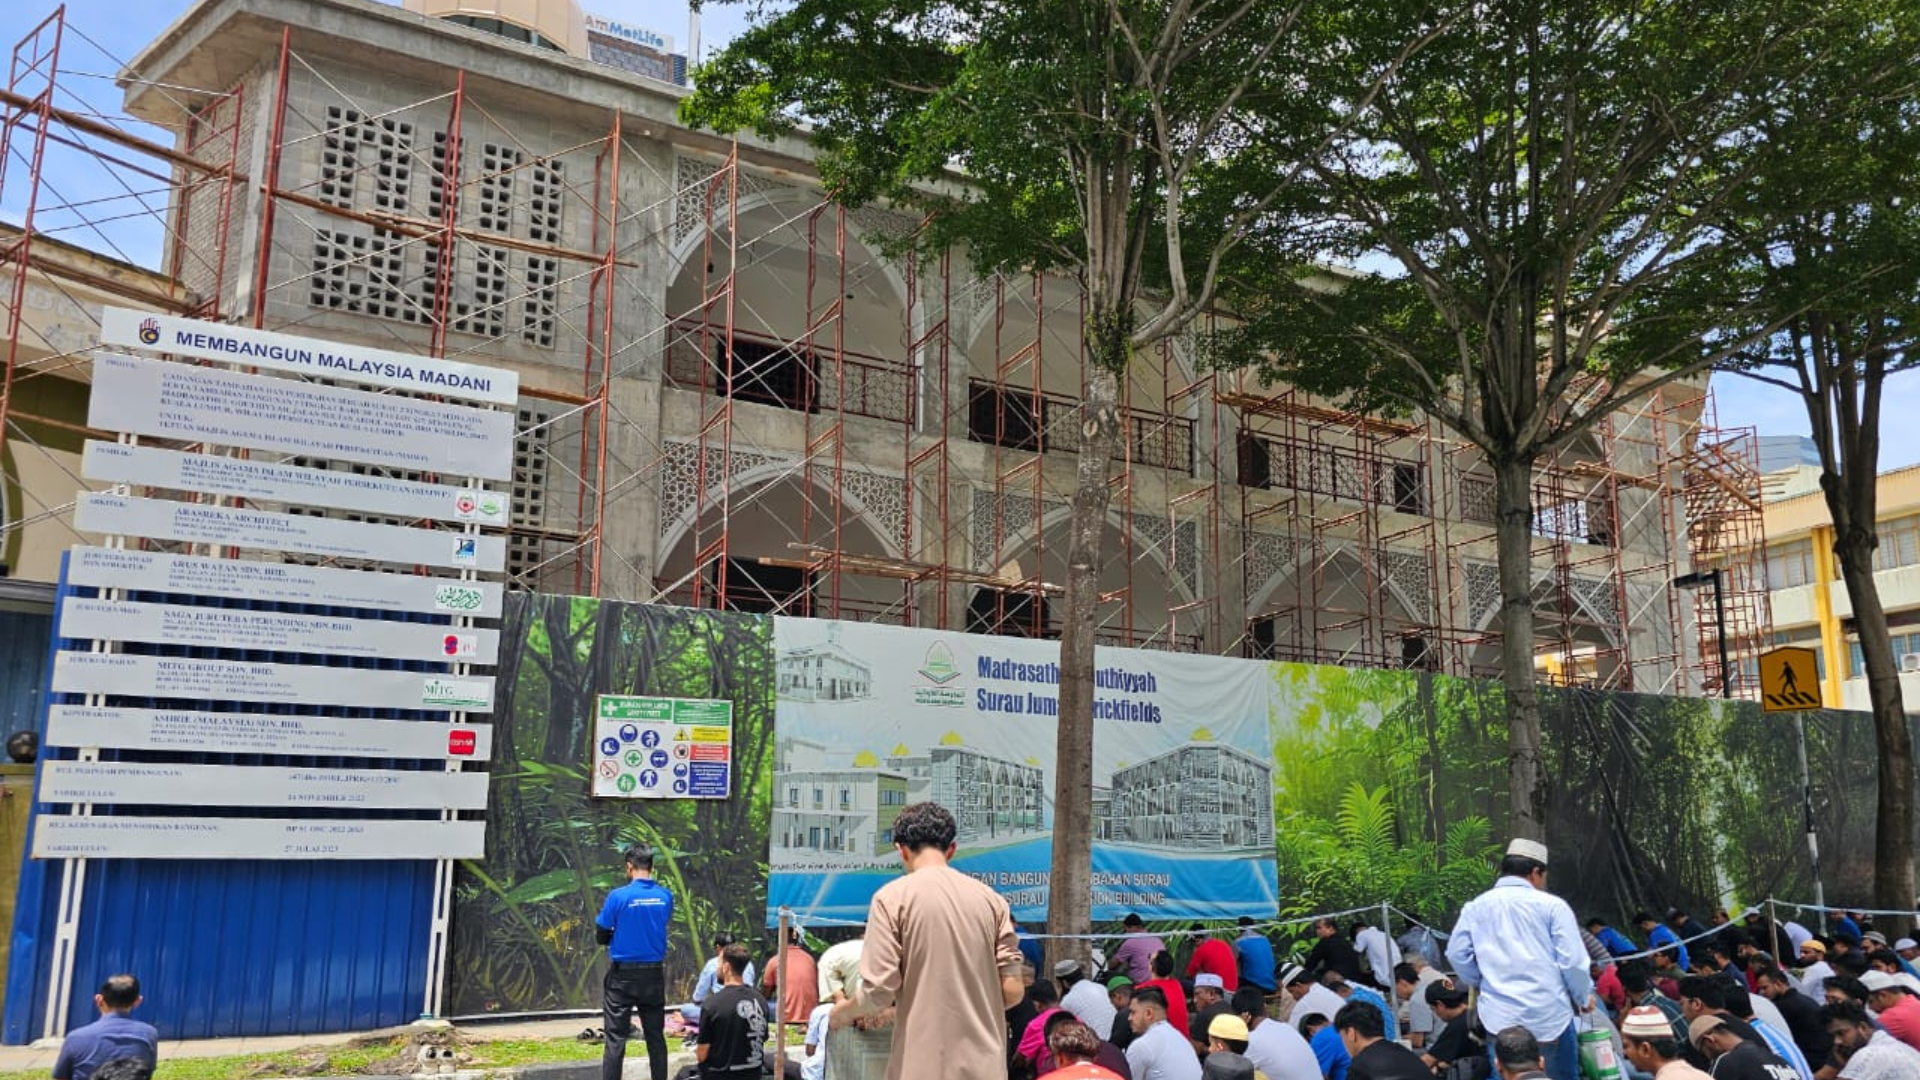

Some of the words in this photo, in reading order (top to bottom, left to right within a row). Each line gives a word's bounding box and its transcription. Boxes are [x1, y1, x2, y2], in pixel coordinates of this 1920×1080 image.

[176, 330, 312, 366] MEMBANGUN
[318, 353, 414, 380] MALAYSIA
[419, 370, 491, 393] MADANI
[182, 458, 221, 471] MAJLIS
[223, 462, 259, 475] AGAMA
[261, 467, 291, 479] ISLAM
[293, 471, 340, 485] WILAYAH
[343, 477, 410, 493] PERSEKUTUAN
[411, 485, 451, 498] (MAIWP)
[234, 513, 290, 527] ARCHITECT
[170, 559, 197, 569] ARUS
[240, 565, 262, 575] SDN.
[263, 567, 286, 577] BHD.
[163, 610, 191, 620] SAGA
[194, 612, 246, 624] JURUTERA
[249, 616, 307, 628] PERUNDING
[156, 661, 185, 671] MITG
[188, 663, 224, 673] GROUP
[250, 667, 274, 676] BHD.
[977, 656, 1059, 684] Madrasath
[1096, 667, 1156, 693] uthiyyah
[976, 688, 1022, 713] Surau
[1027, 693, 1057, 716] Jum
[1093, 698, 1161, 723] rickfields
[194, 716, 255, 727] (MALAYSIA)
[297, 793, 346, 801] NOVEMBER
[1000, 872, 1051, 886] BANGUN
[1090, 873, 1131, 886] BAHAN
[1133, 874, 1170, 886] SURAU
[1006, 891, 1045, 905] SURAU
[1115, 892, 1165, 906] BUILDING
